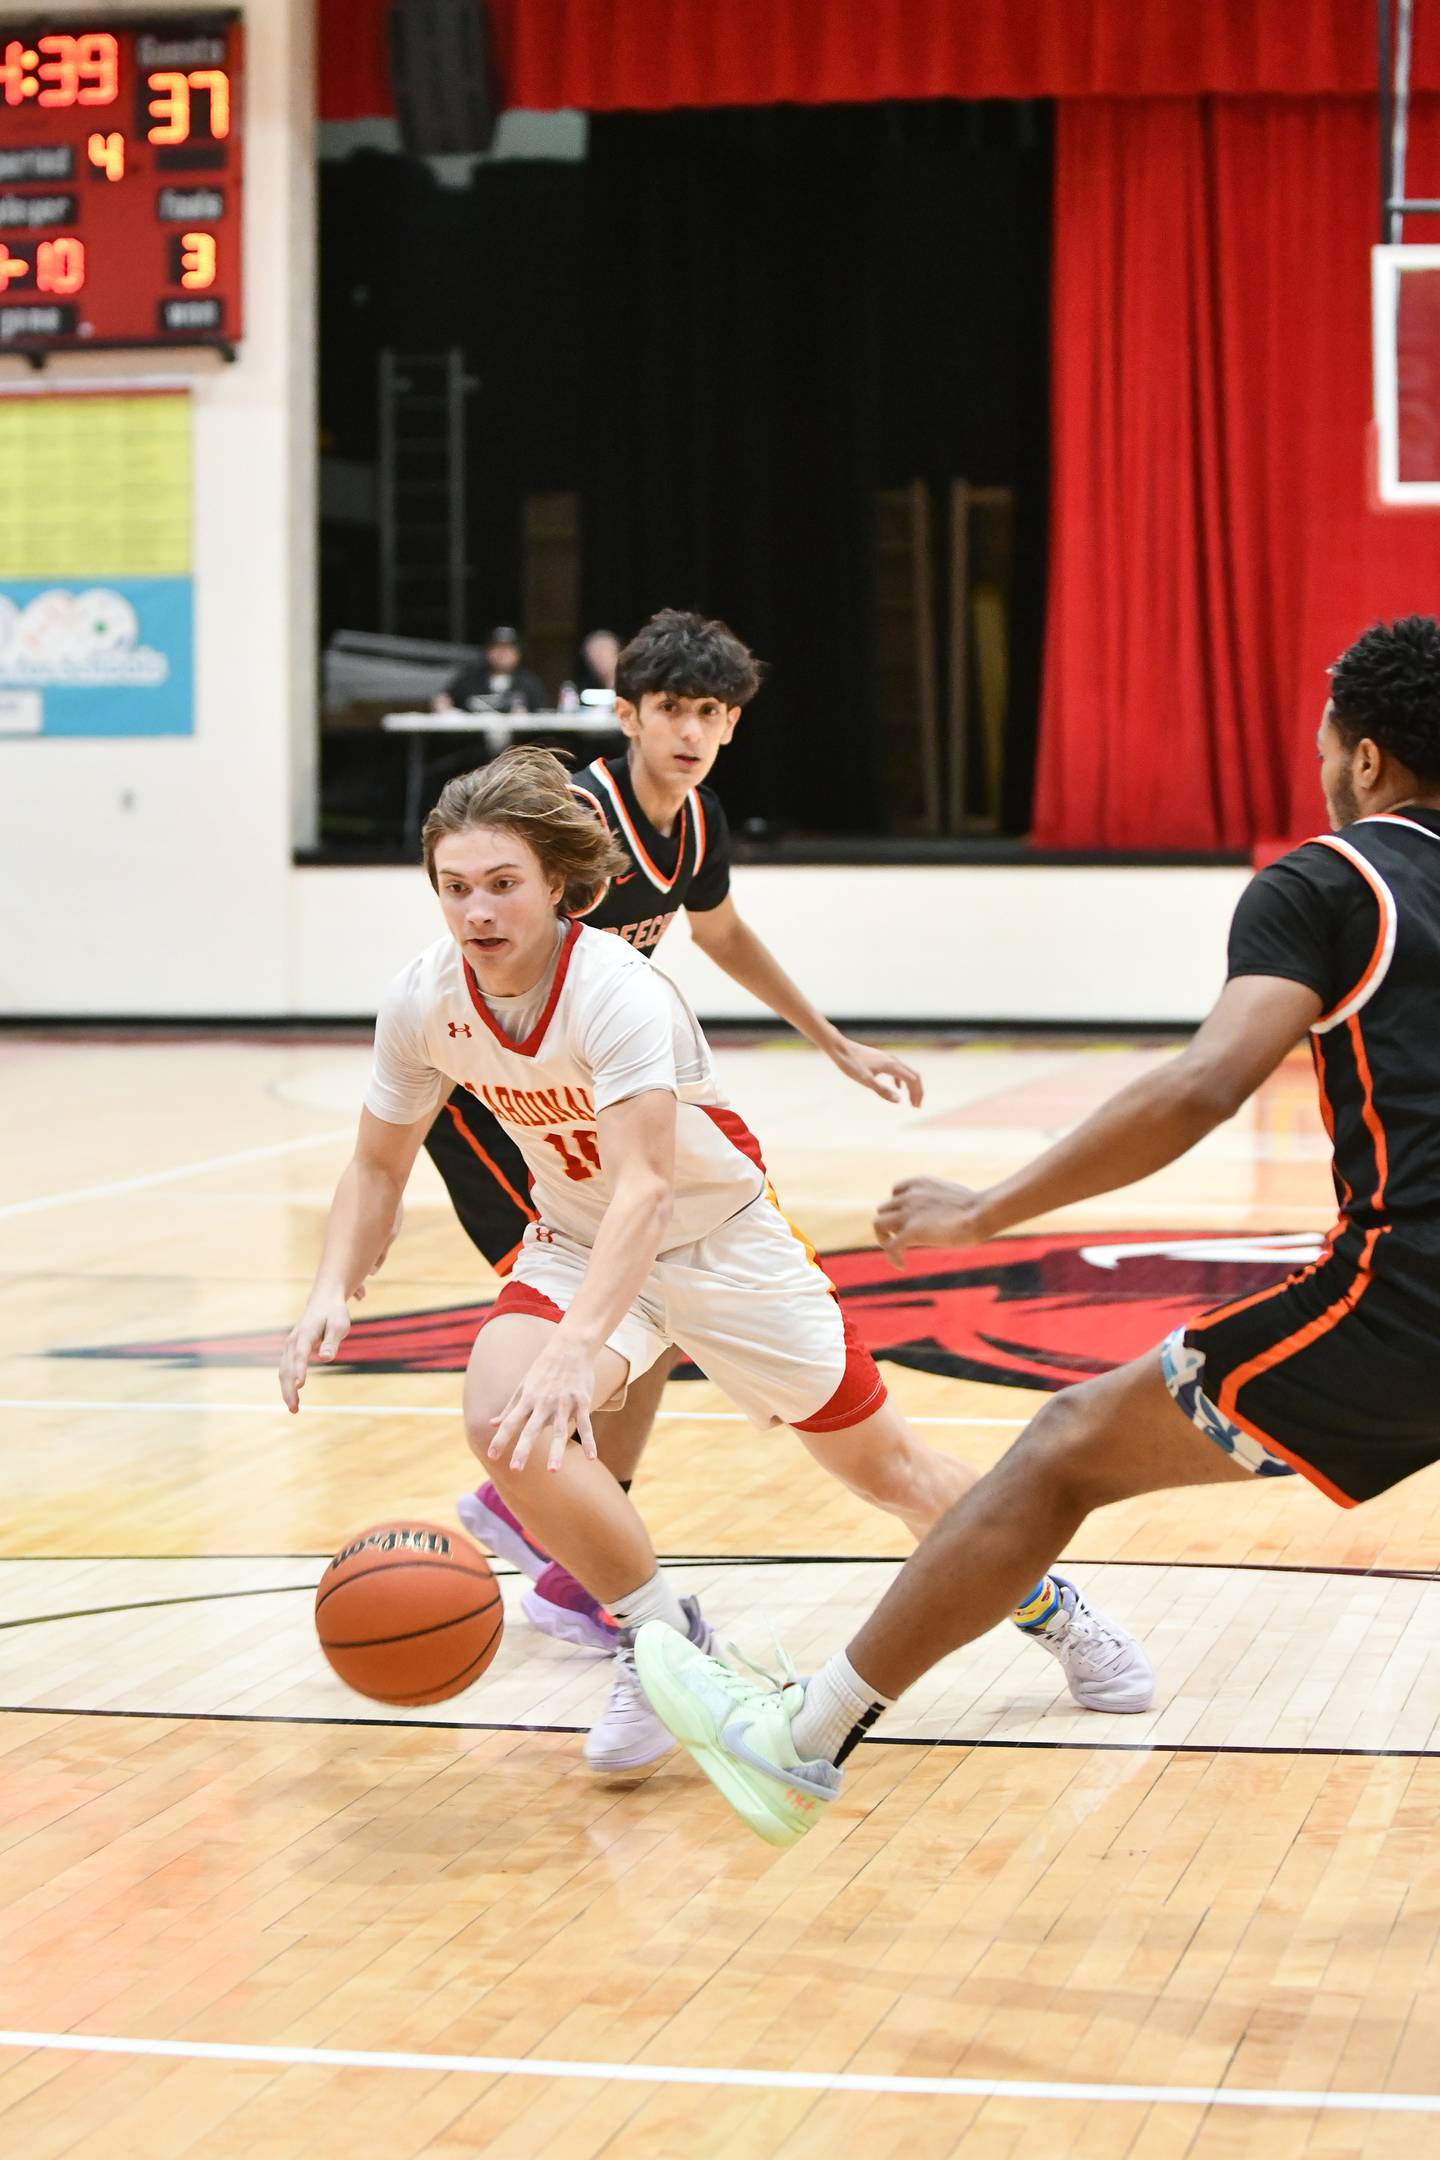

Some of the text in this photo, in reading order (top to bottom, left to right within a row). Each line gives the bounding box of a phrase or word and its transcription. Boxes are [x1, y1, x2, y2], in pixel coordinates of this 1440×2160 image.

[148, 71, 229, 144] 37
[88, 133, 124, 182] 4
[181, 233, 216, 289] 3
[601, 910, 678, 949] EEC
[464, 1081, 598, 1127] ARDINAL
